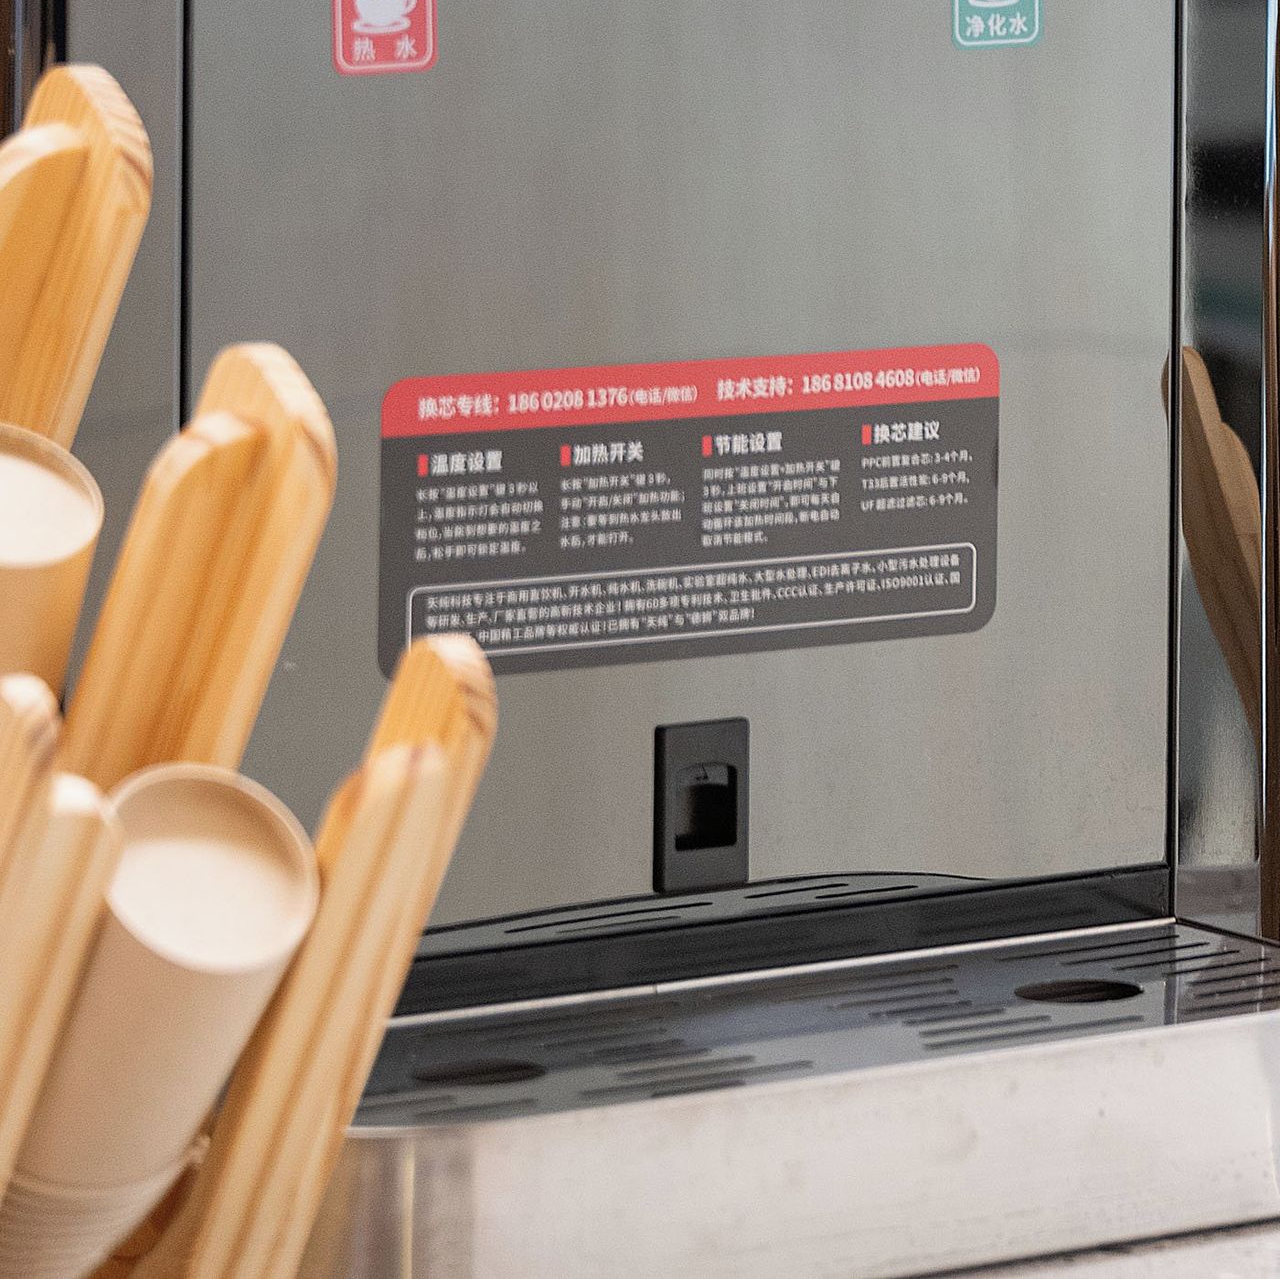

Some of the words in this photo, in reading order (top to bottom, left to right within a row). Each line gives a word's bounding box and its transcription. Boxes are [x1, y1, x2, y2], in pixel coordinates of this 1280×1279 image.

[965, 13, 1028, 37] 净化水
[716, 432, 782, 455] 节能设置
[874, 421, 939, 443] 换芯建议
[432, 451, 502, 474] 温度设置
[574, 442, 643, 464] 加热开关
